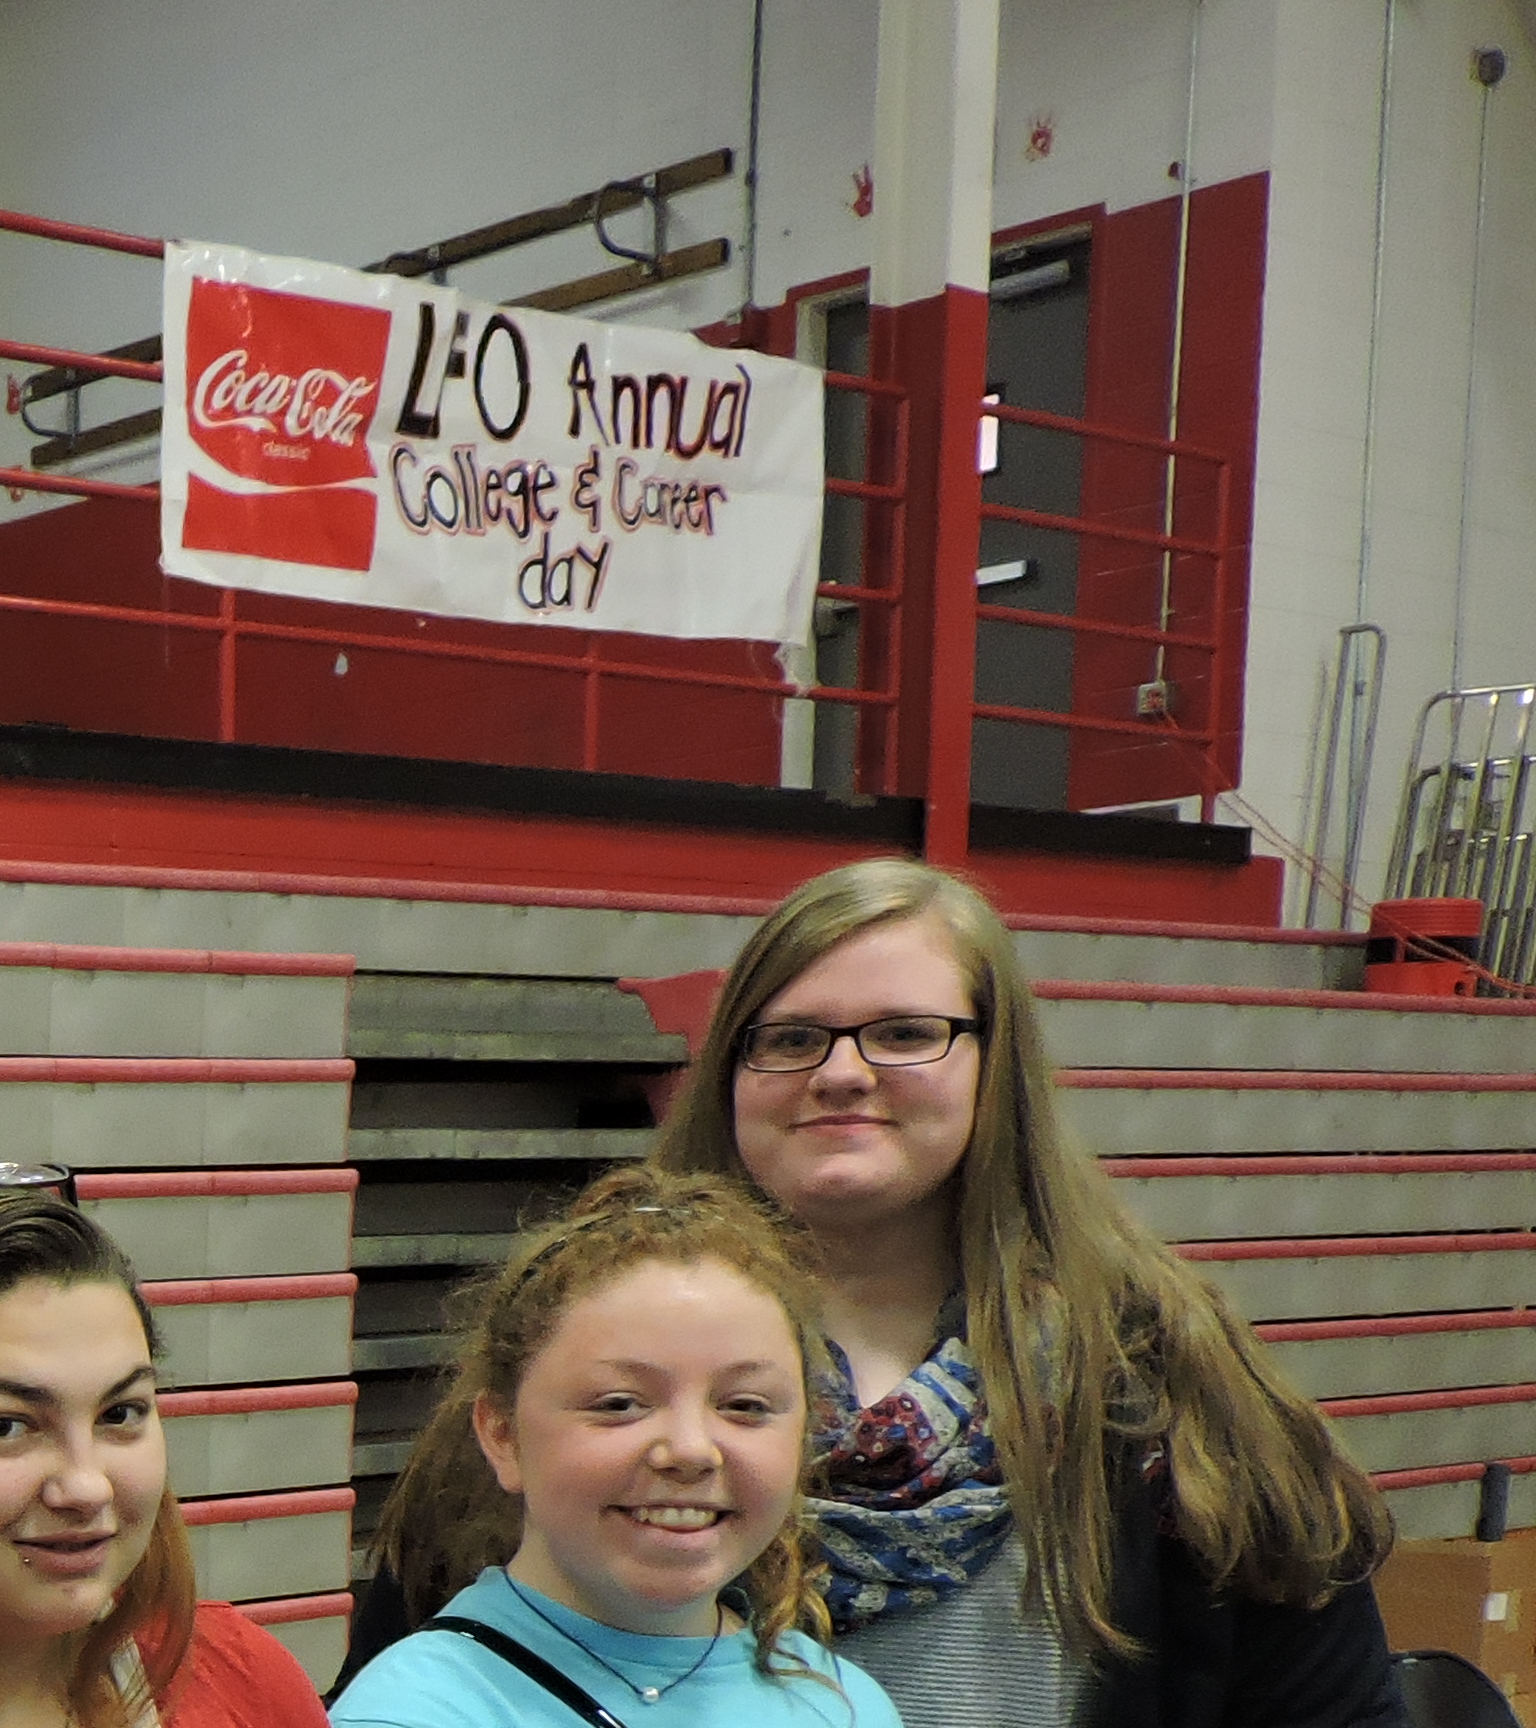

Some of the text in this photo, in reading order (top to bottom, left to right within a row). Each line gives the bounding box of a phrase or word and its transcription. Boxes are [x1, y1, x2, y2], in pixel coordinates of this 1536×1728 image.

[194, 349, 376, 447] Coca-Cola
[569, 343, 751, 459] Annual
[392, 446, 726, 540] College & Career
[519, 532, 611, 611] day
